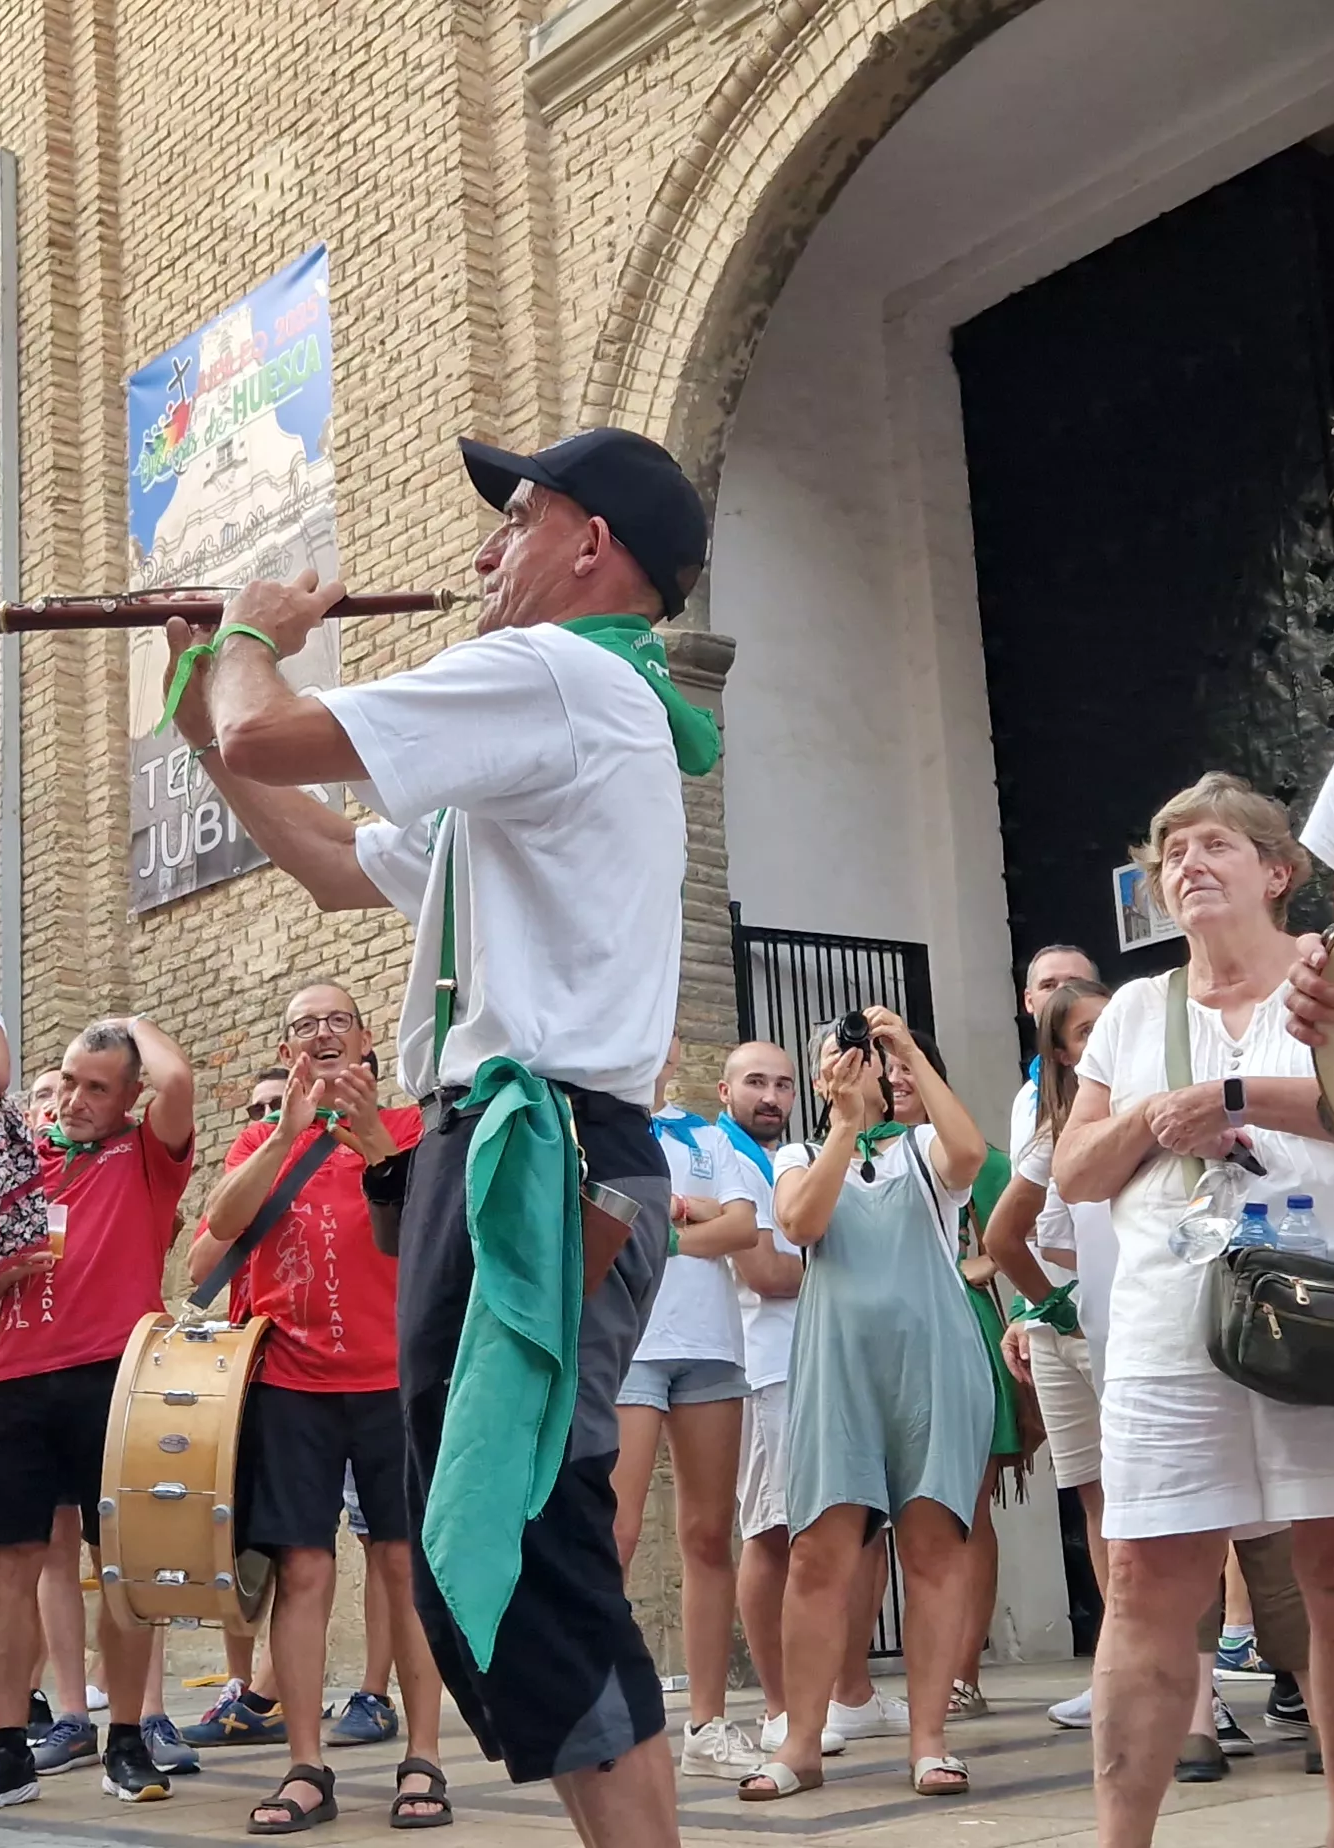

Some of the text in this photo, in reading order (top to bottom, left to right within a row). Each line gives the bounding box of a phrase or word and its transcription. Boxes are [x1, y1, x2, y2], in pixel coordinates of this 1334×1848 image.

[274, 295, 320, 347] 2025
[204, 406, 229, 447] de
[232, 334, 322, 426] HUESCA
[139, 800, 238, 878] JUBI
[290, 1201, 313, 1216] LA
